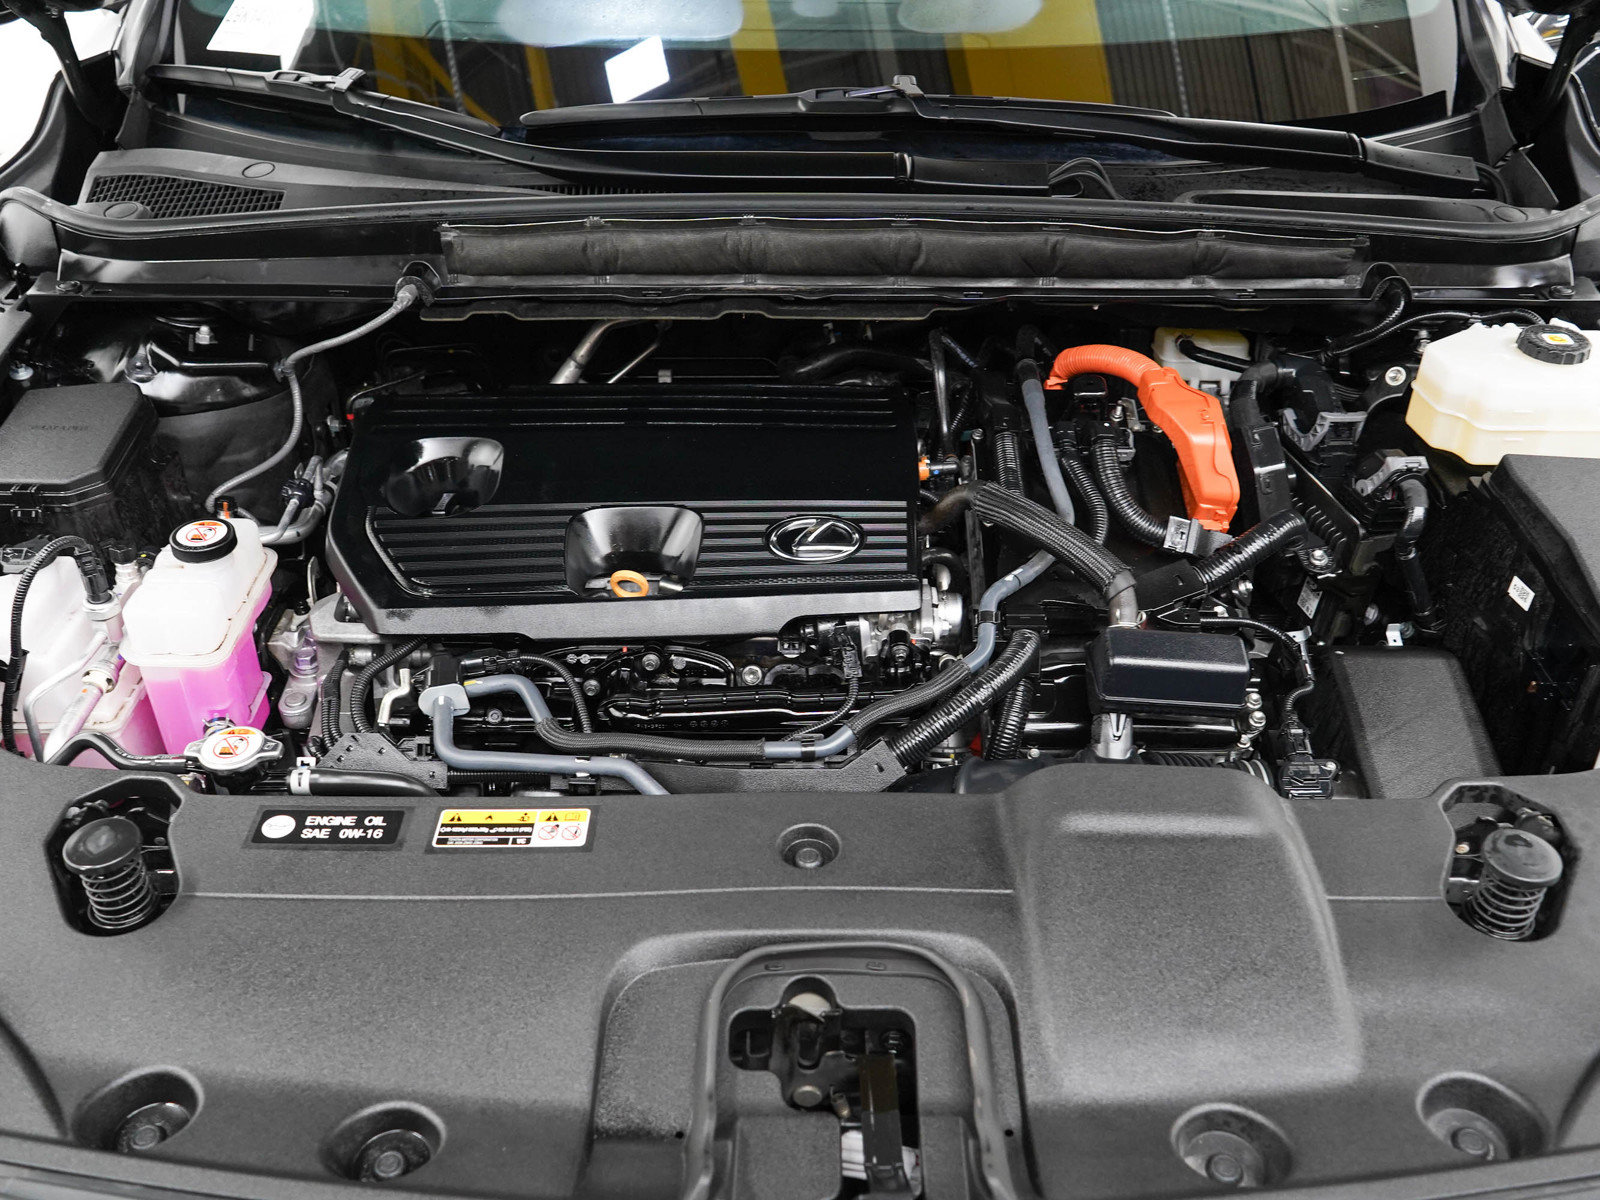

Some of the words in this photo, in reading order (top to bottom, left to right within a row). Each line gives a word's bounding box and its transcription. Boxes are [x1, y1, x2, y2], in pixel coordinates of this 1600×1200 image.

[304, 815, 358, 826] ENGINE
[363, 815, 387, 826] OIL
[300, 828, 332, 839] SAE
[338, 828, 383, 839] 0W-16
